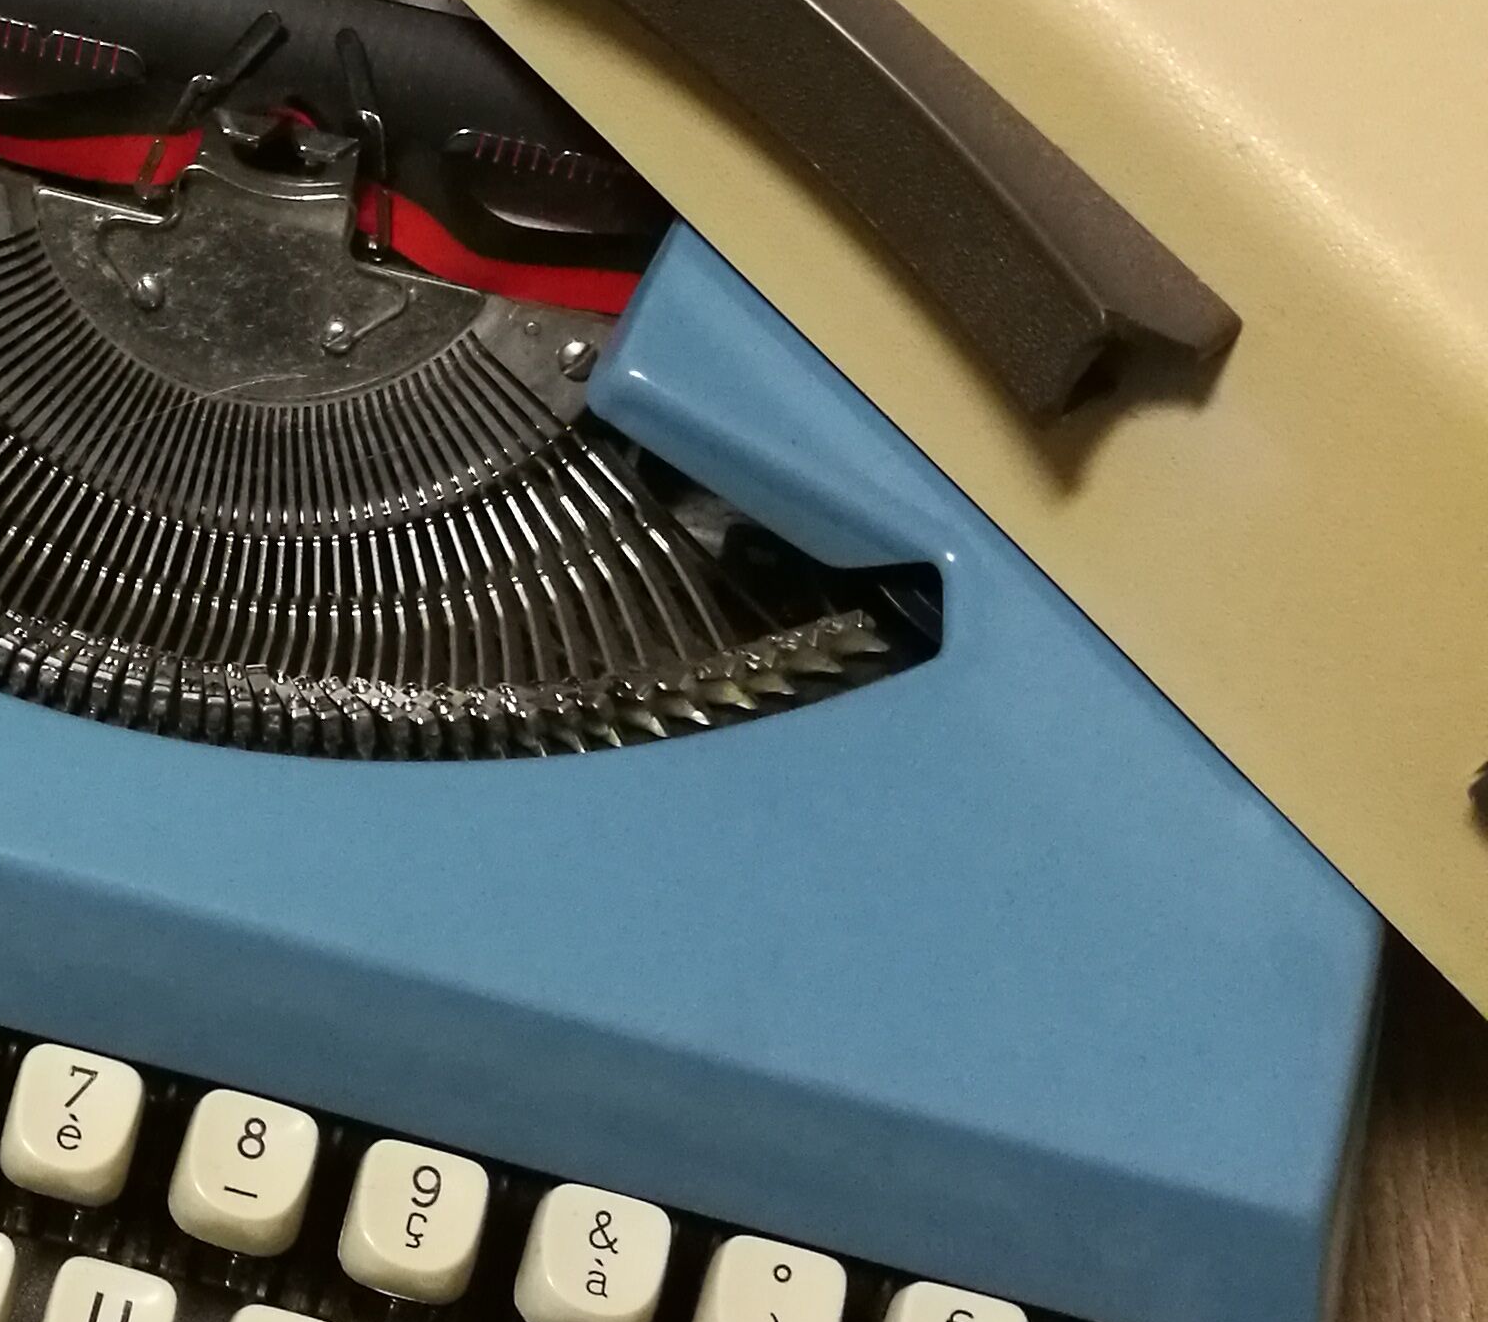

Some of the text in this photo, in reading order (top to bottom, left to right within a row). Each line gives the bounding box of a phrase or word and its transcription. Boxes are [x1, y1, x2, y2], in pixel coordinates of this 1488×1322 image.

[64, 1065, 99, 1108] 7
[55, 1112, 83, 1151] è
[236, 1117, 268, 1160] 8
[411, 1165, 442, 1209] 9
[405, 1212, 428, 1249] ç
[588, 1209, 619, 1255] &
[585, 1258, 609, 1299] à
